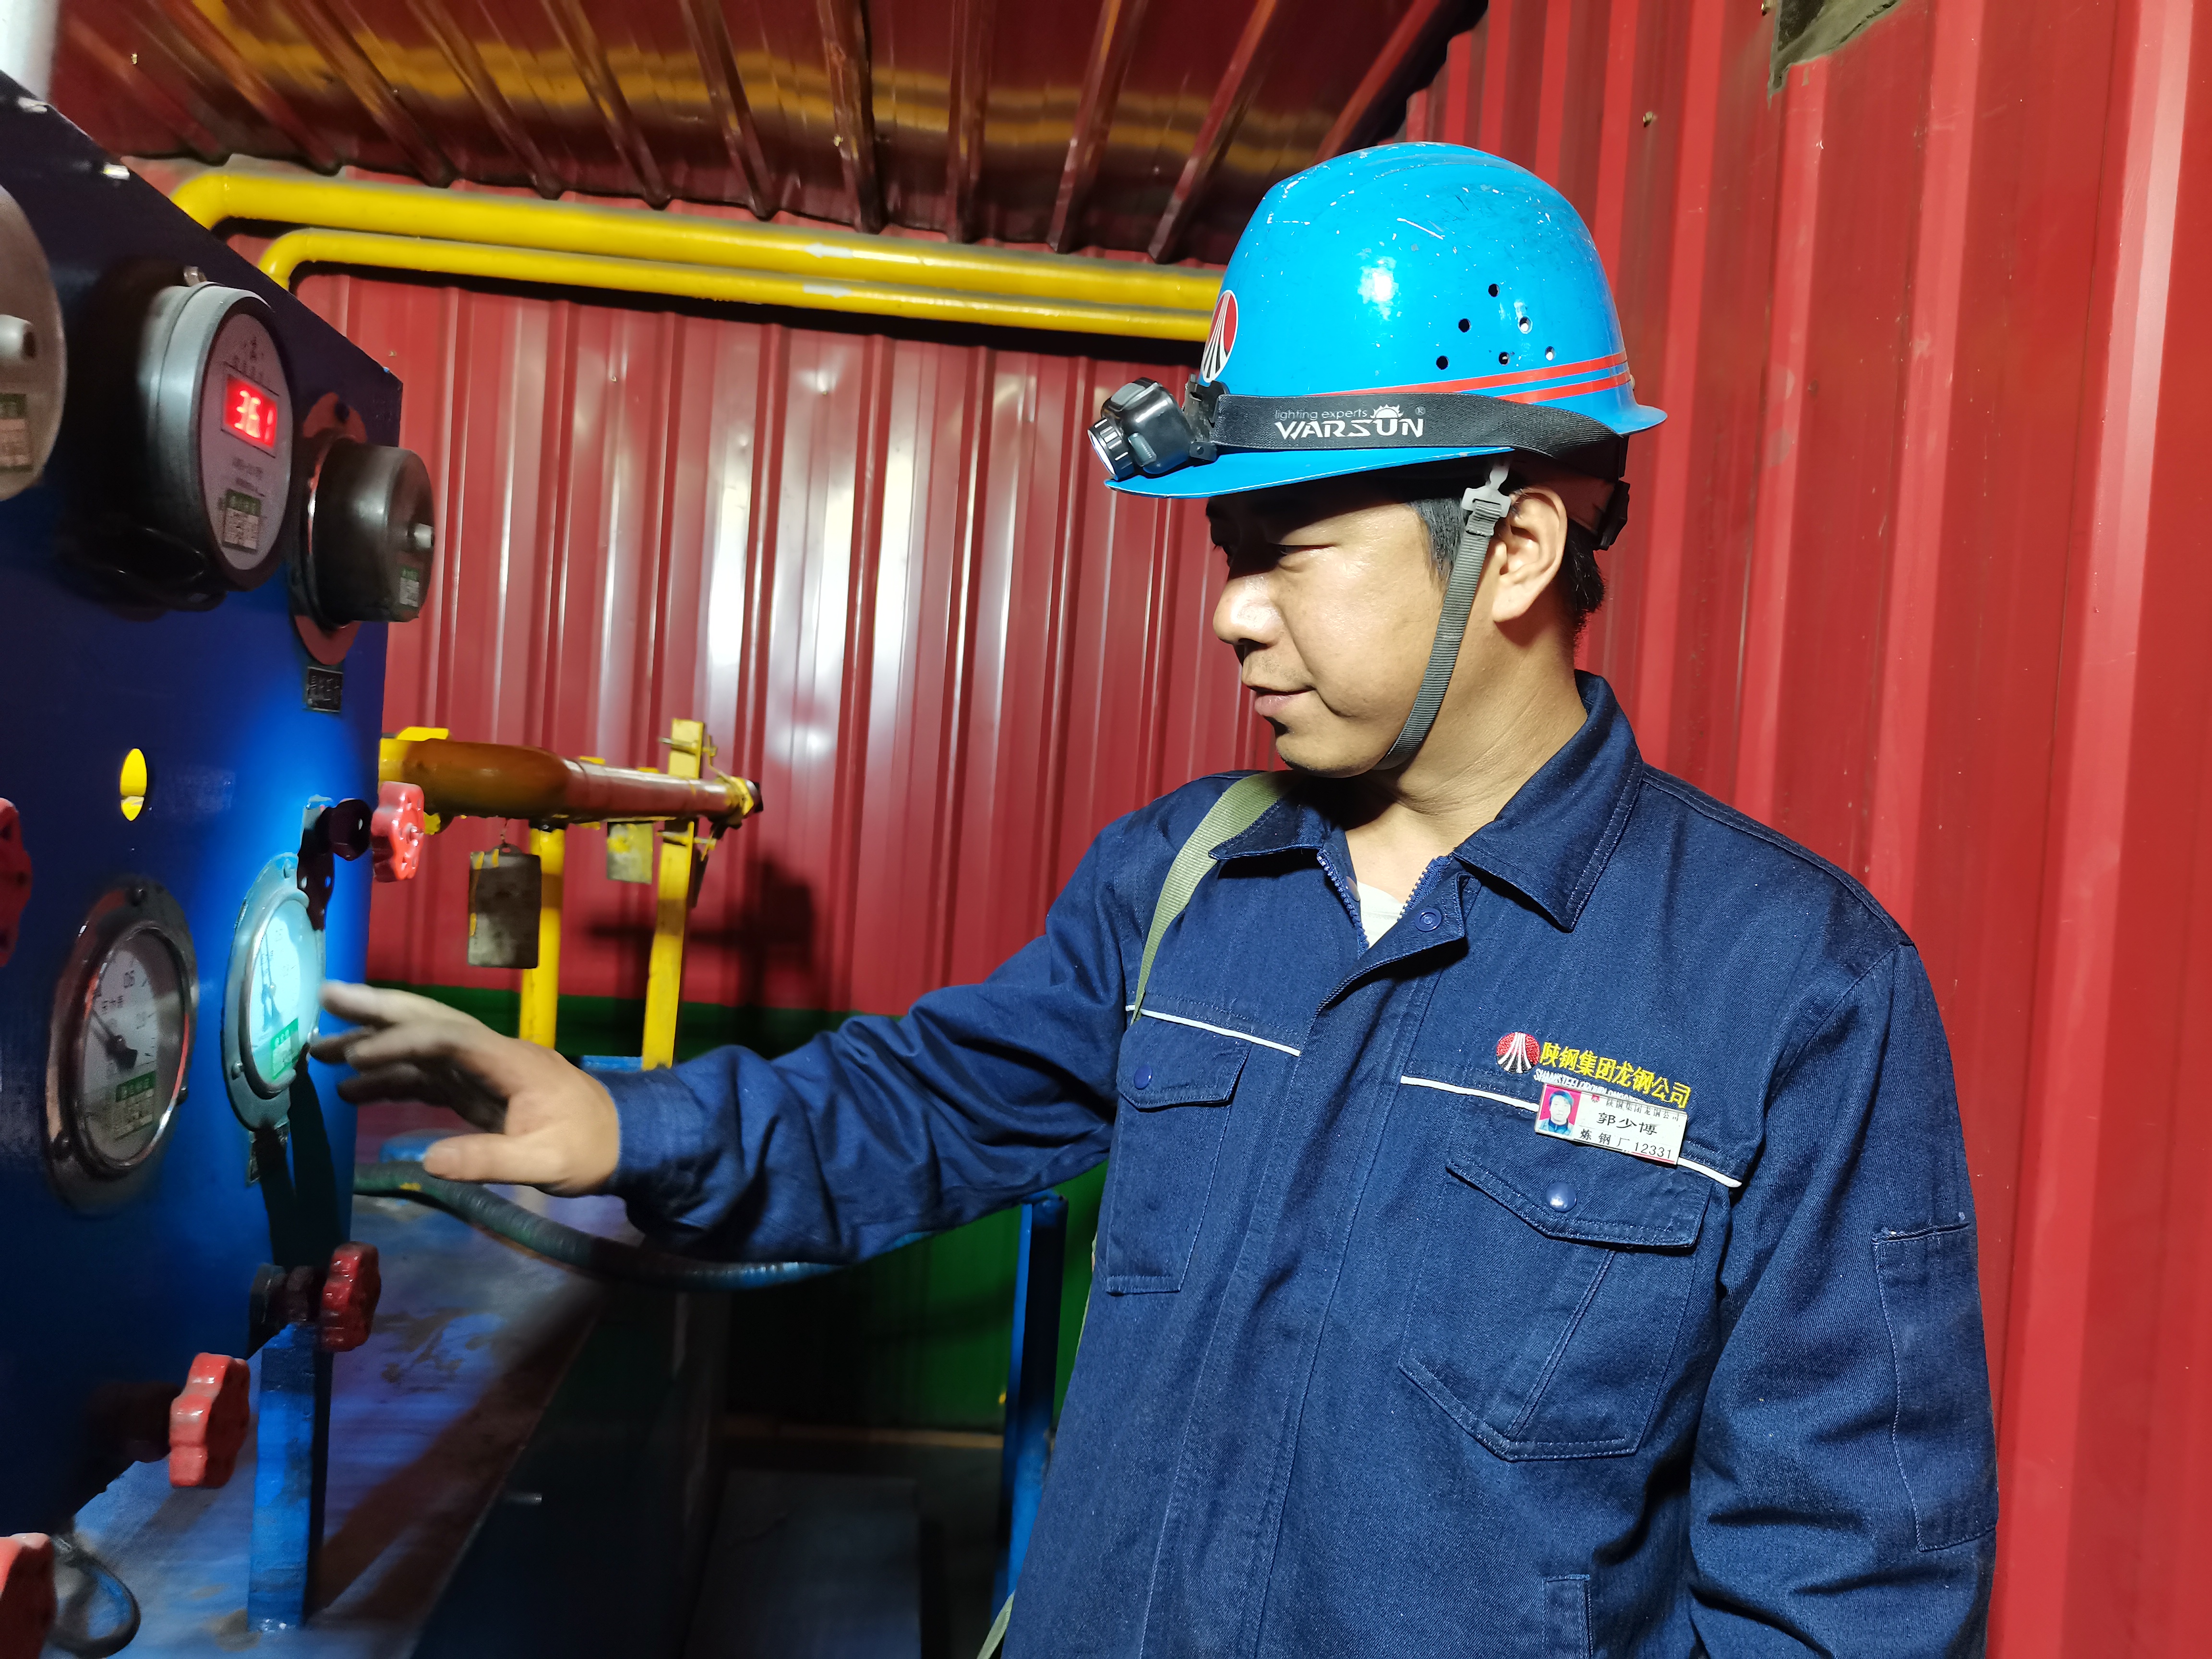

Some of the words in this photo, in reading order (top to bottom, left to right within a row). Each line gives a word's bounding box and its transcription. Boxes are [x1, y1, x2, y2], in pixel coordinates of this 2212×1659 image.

[1274, 409, 1318, 421] lighting
[1321, 408, 1368, 420] experts
[1274, 418, 1424, 440] WARSUN
[1539, 1041, 1692, 1109] 陕钢集团龙钢公司
[1596, 1112, 1658, 1135] 郭少博
[1634, 1142, 1672, 1159] 12331
